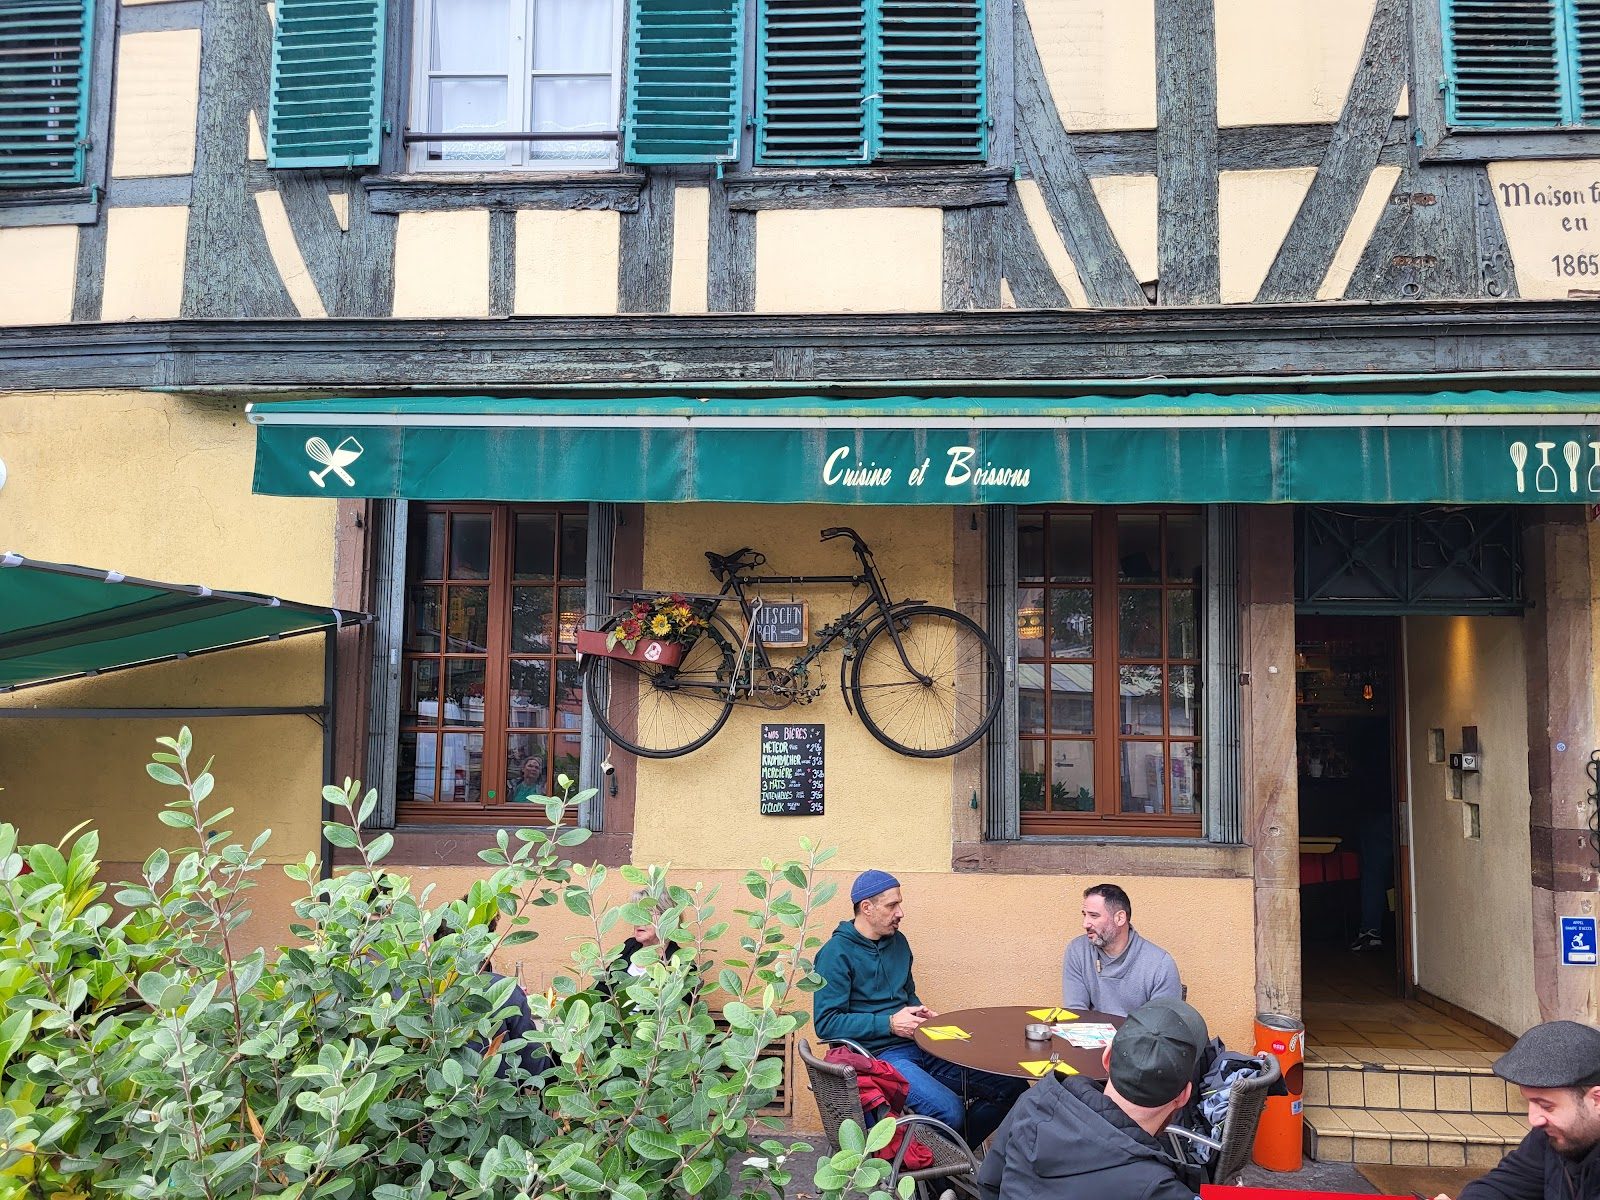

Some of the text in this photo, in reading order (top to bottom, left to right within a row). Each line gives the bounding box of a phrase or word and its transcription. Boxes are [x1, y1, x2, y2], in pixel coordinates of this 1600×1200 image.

[1499, 182, 1585, 208] Maison
[1561, 216, 1588, 232] en
[1551, 254, 1600, 277] 1865
[822, 446, 1030, 487] Cuisine et Boissons
